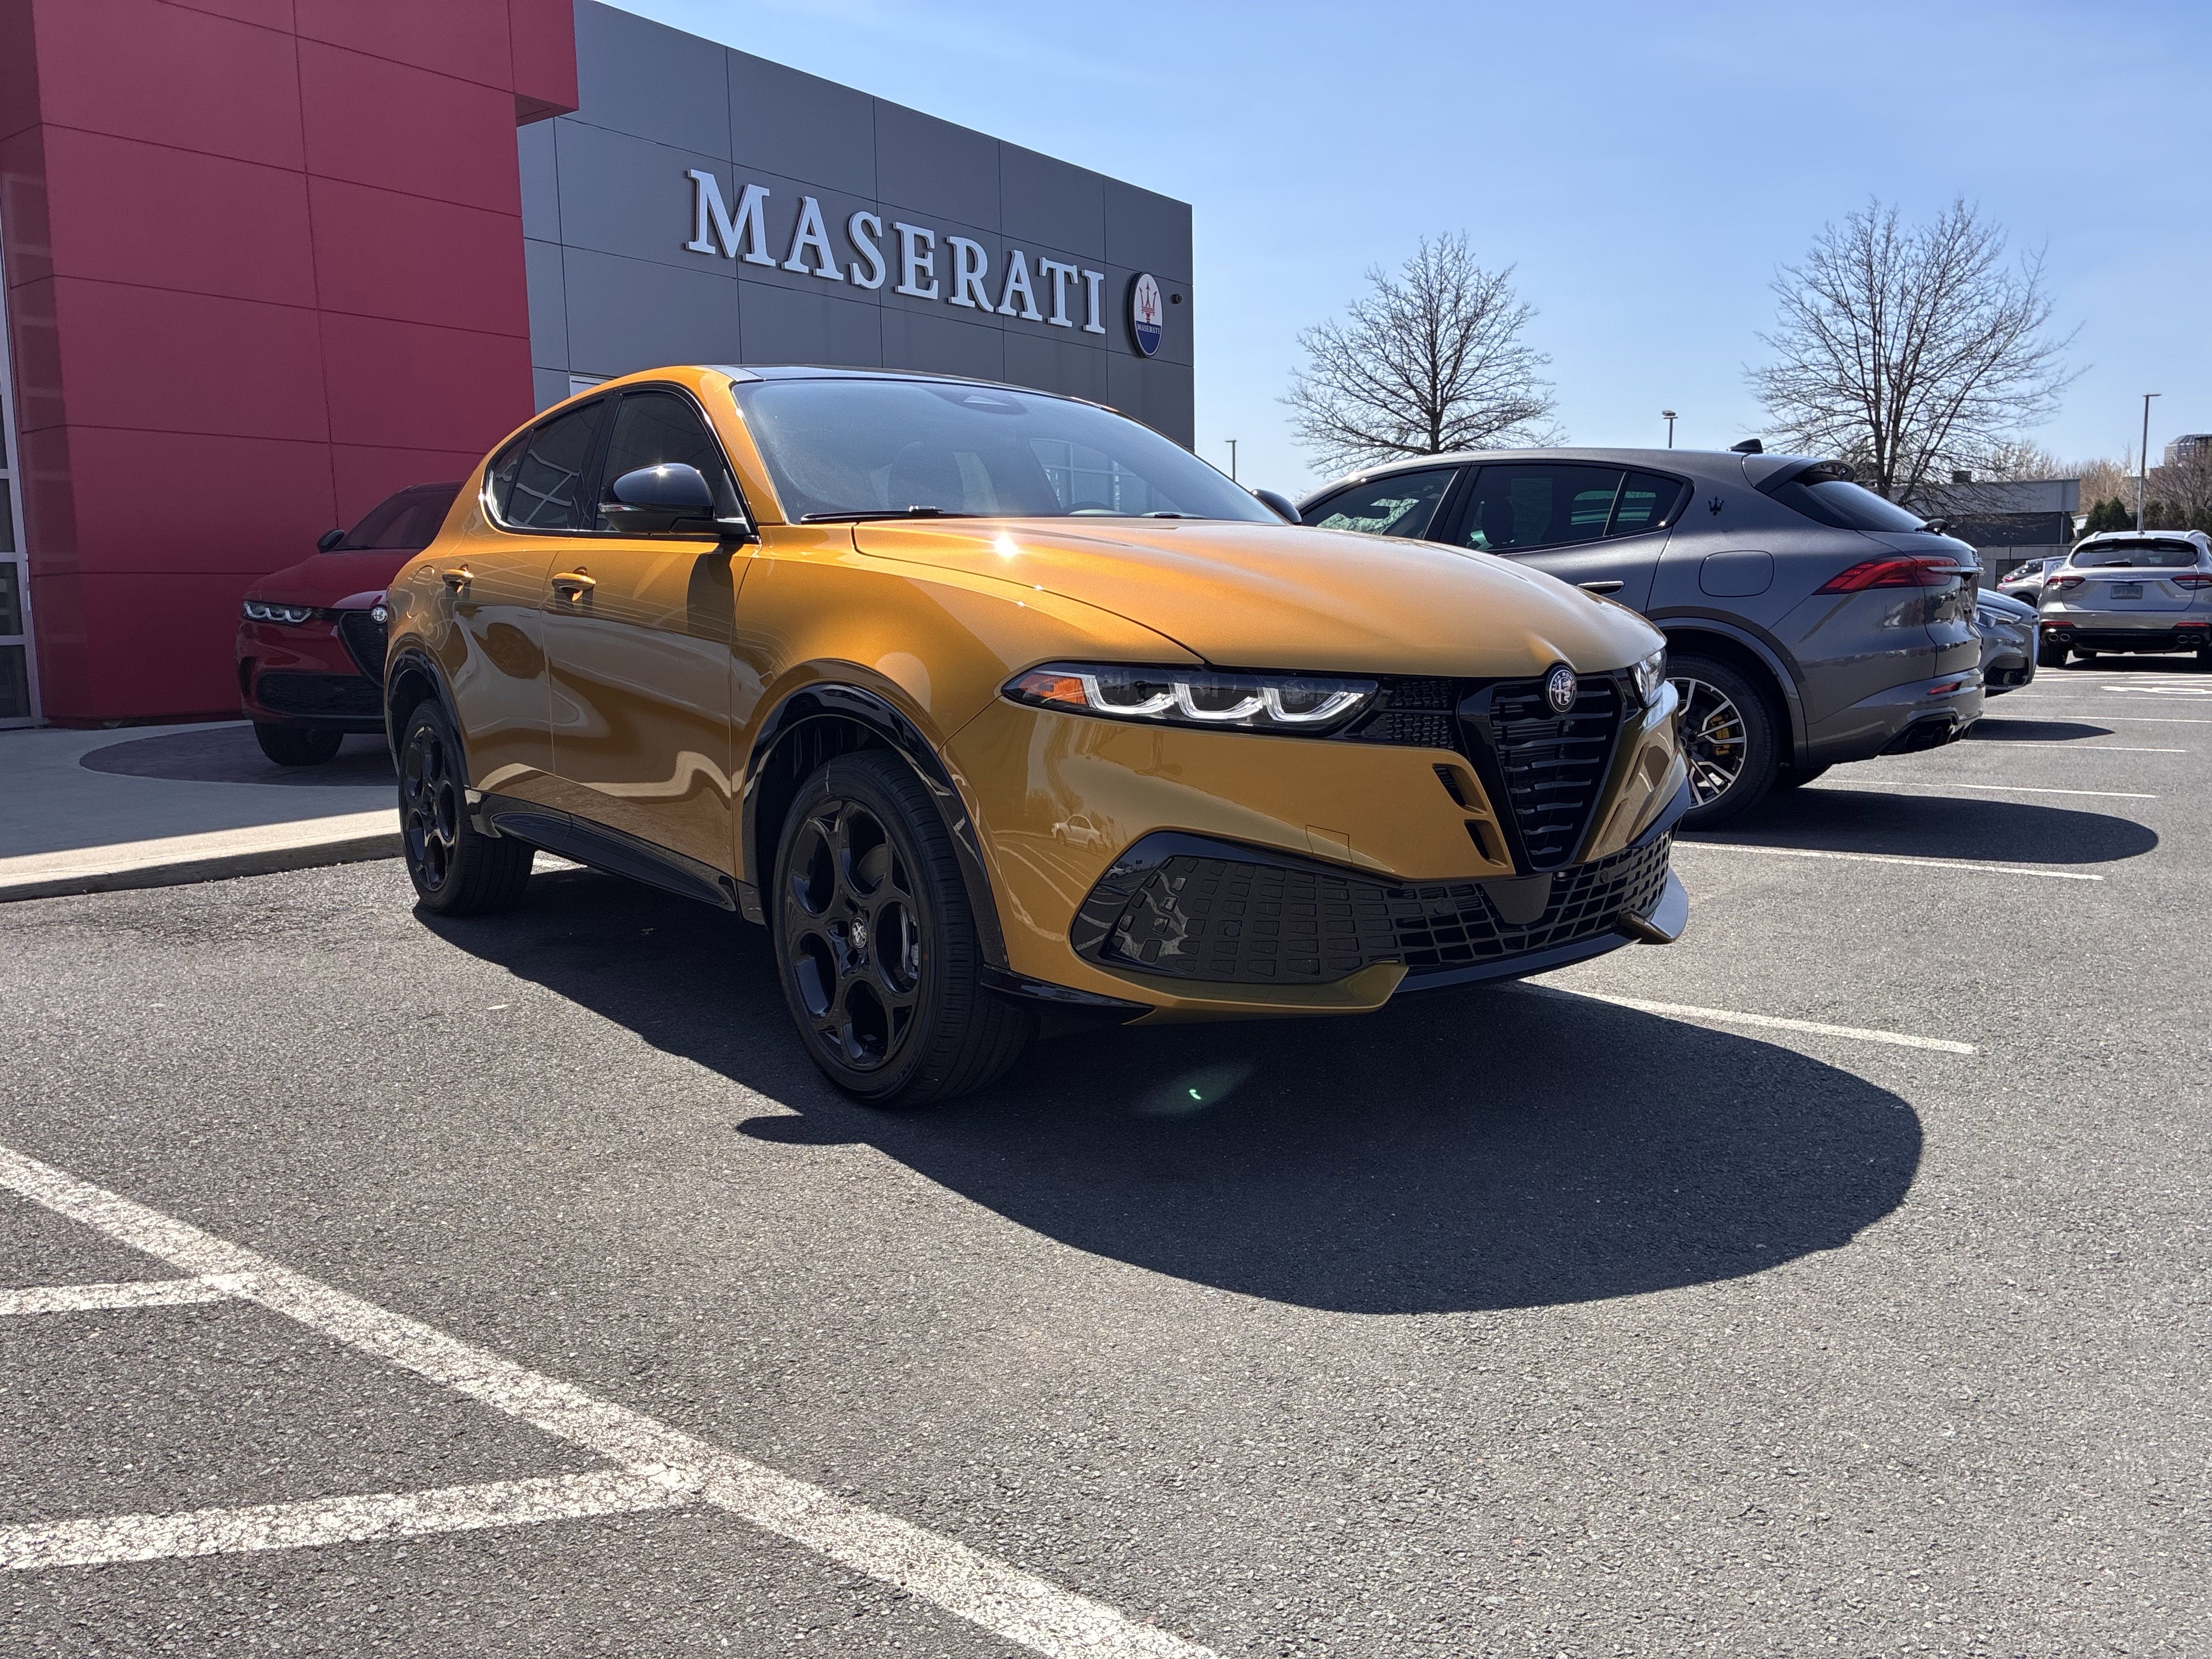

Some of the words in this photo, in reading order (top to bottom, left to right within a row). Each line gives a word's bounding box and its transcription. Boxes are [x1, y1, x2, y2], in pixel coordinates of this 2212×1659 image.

[686, 168, 1106, 335] MASERATI
[1137, 324, 1160, 335] MASERATI
[1551, 675, 1561, 692] ALFA
[1562, 672, 1576, 691] ROMEO
